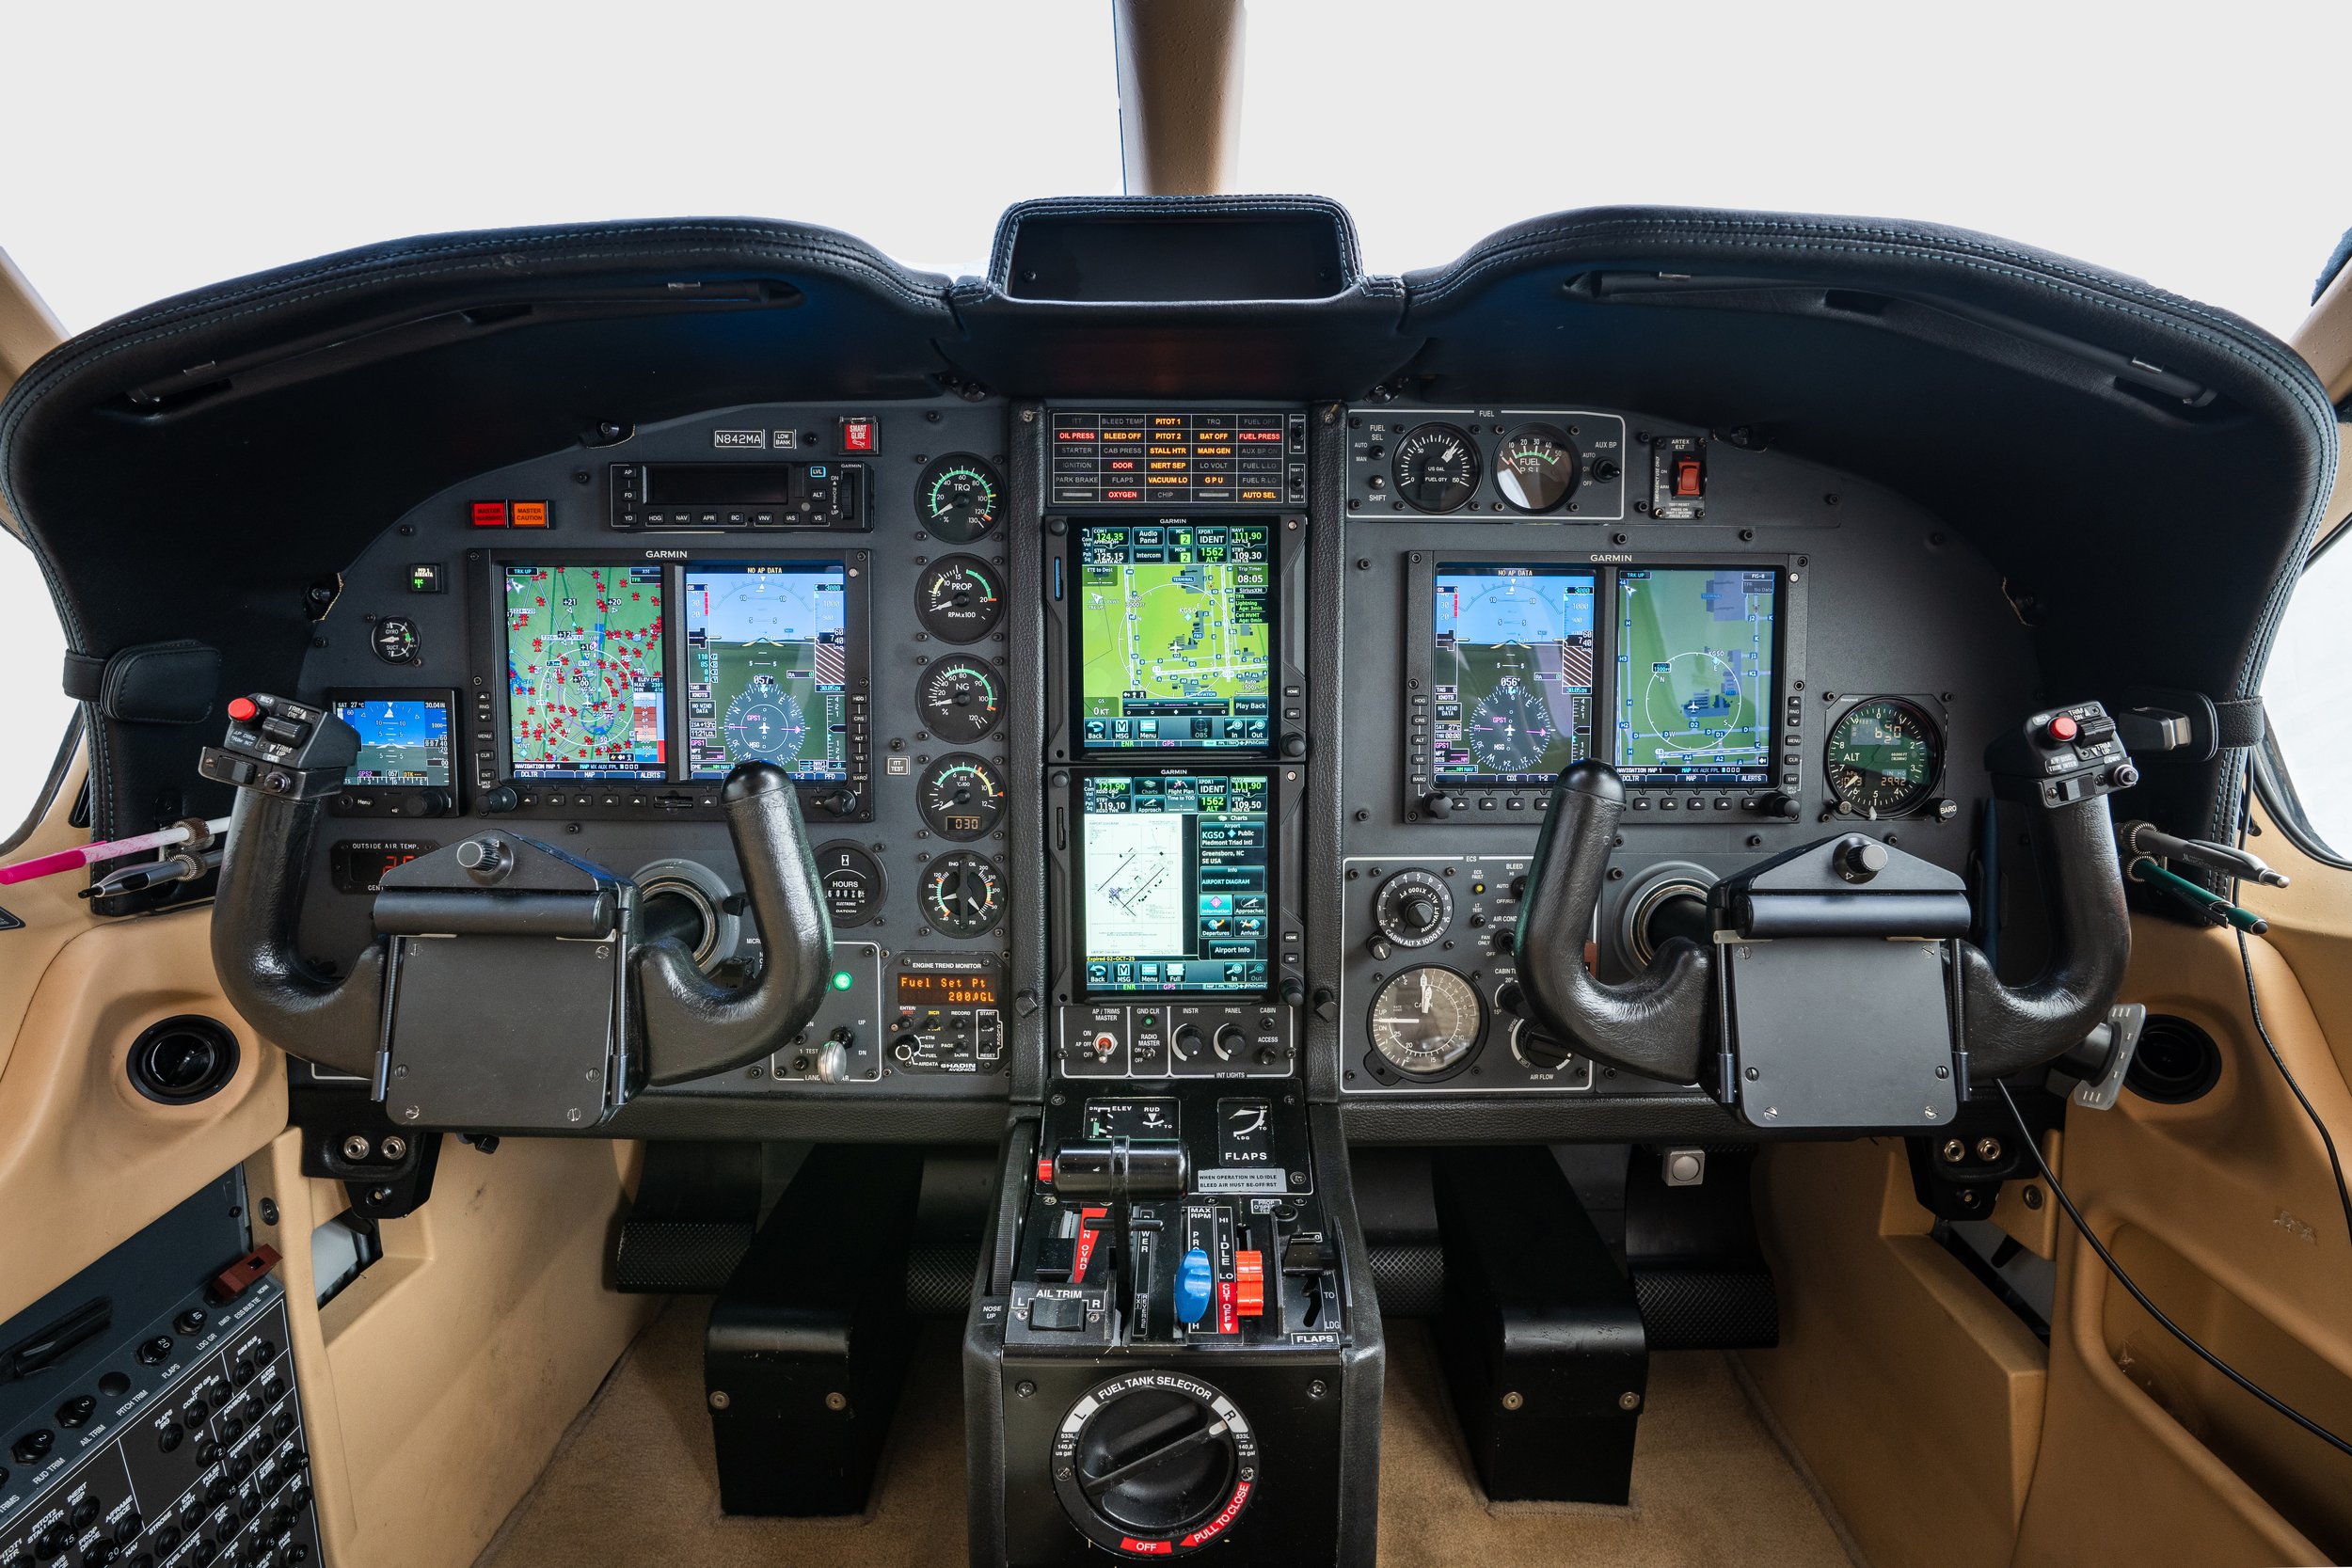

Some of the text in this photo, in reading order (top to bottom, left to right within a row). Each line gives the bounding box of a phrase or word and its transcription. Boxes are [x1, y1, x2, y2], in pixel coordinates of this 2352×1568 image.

[850, 424, 866, 433] SMART
[716, 434, 761, 444] N842MA
[1056, 476, 1099, 484] PARK BRAKE
[1111, 476, 1134, 484] FLAPS
[1148, 476, 1188, 484] VACUUM LO
[954, 483, 971, 492] TRQ
[1096, 532, 1124, 542] 124.35
[1200, 535, 1225, 544] IDENT
[645, 550, 688, 559] GARMIN
[1200, 547, 1224, 556] 1562
[1234, 551, 1262, 560] 109.30
[1097, 552, 1124, 561] 125.15
[1590, 554, 1632, 562] GARMIN
[1237, 575, 1263, 584] 08:05
[951, 582, 973, 591] PROP
[956, 683, 970, 691] NG
[1236, 703, 1249, 711] Play
[1843, 752, 1860, 762] ALT
[1940, 805, 1957, 814] BARO
[955, 818, 978, 830] 030
[1202, 832, 1225, 840] KGSO
[1385, 929, 1404, 944] CABIN
[1436, 926, 1444, 935] FT
[1215, 946, 1237, 955] Airport
[901, 977, 986, 989] Fuel Set Pt
[1225, 1152, 1267, 1161] FLAPS
[1220, 1234, 1230, 1266] IDLE
[1036, 1290, 1083, 1299] AIL TRIM
[1092, 1299, 1101, 1308] R
[1222, 1284, 1232, 1323] CUT OFF
[196, 1333, 217, 1351] LDG GR
[162, 1363, 181, 1380] FLAPS
[1098, 1376, 1213, 1401] FUEL TANK SELECTOR
[1073, 1411, 1087, 1420] L
[1223, 1409, 1237, 1422] R
[80, 1424, 106, 1447] AIL TRIM
[32, 1457, 66, 1485] RUD TRIM
[67, 1481, 87, 1502] INERT
[71, 1491, 86, 1506] SEP
[1193, 1484, 1249, 1544] PULL TO CLOSE
[148, 1511, 173, 1536] STROBE
[1136, 1543, 1157, 1552] OFF
[107, 1546, 120, 1560] 20
